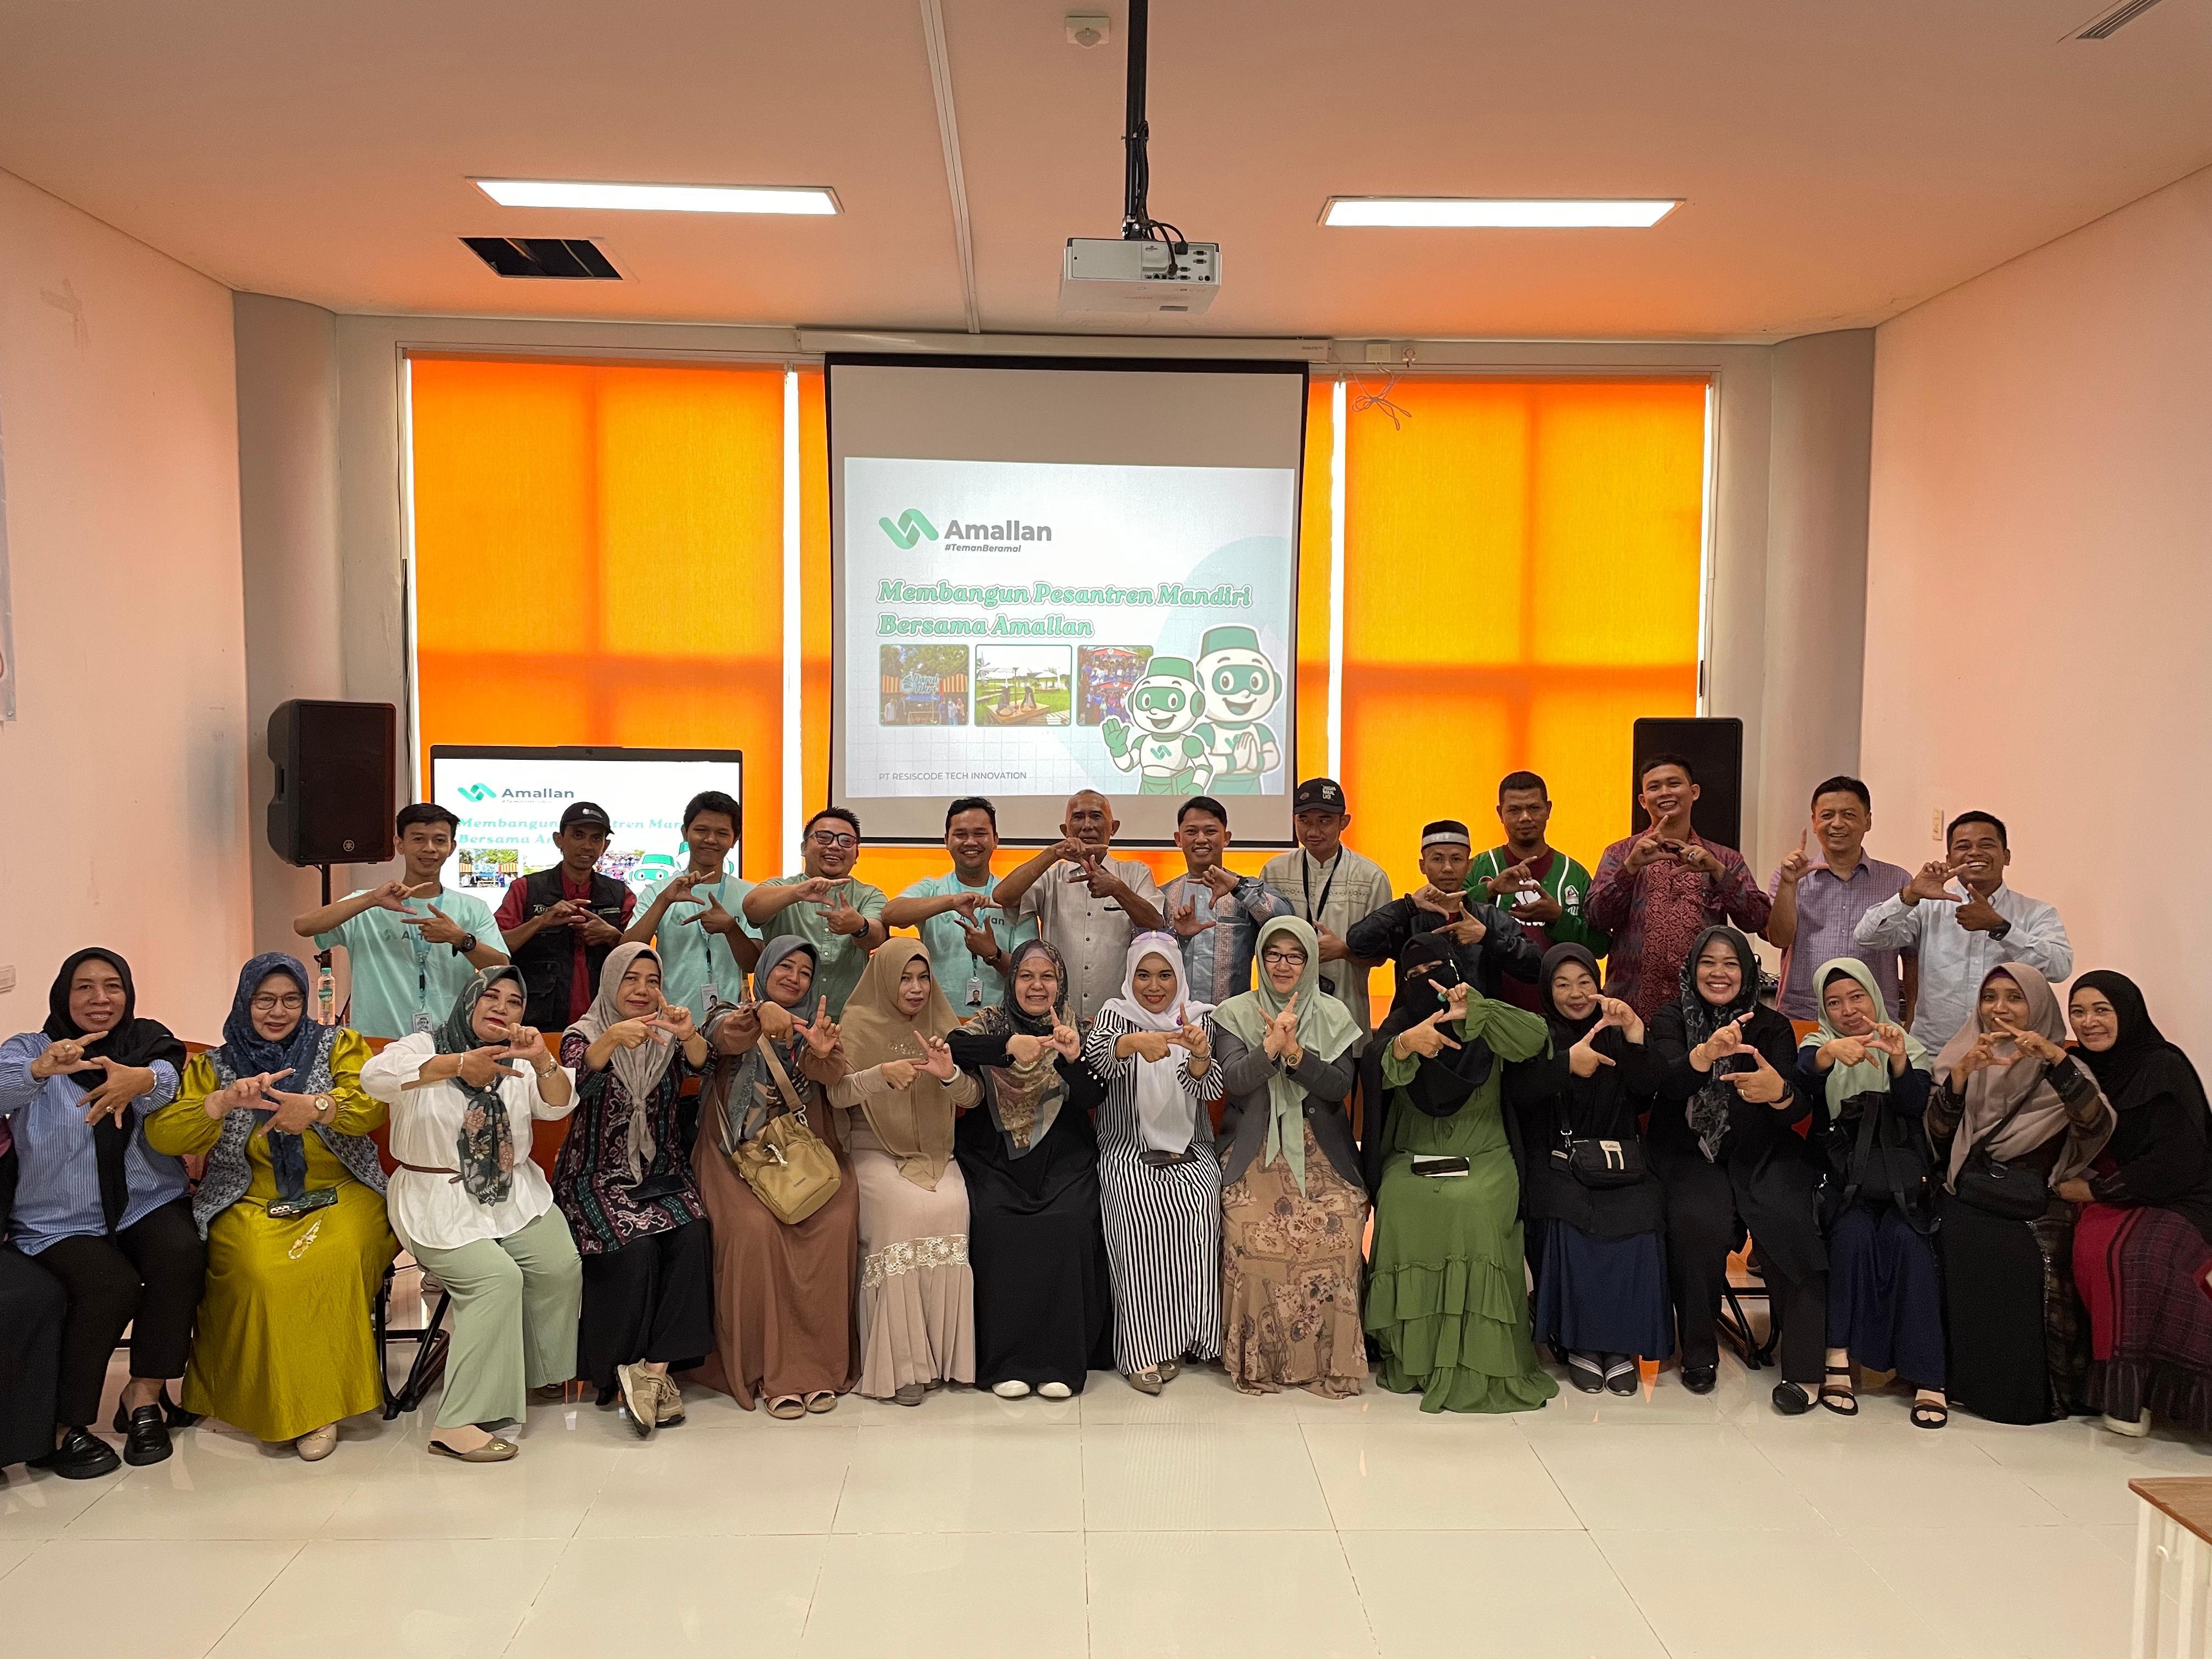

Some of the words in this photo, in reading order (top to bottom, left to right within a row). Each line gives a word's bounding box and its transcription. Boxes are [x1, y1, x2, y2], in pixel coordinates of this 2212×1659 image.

[944, 520, 1052, 541] Amallan
[945, 544, 1022, 552] #TemanBeramal
[878, 580, 1029, 607] Membangun
[1033, 583, 1153, 604] Pesantren
[1157, 585, 1251, 606] Mandiri
[878, 614, 988, 635] Bersama
[990, 615, 1093, 636] Amallan
[501, 788, 574, 798] Amallan
[458, 818, 558, 830] Membangun
[459, 834, 530, 844] Bersama
